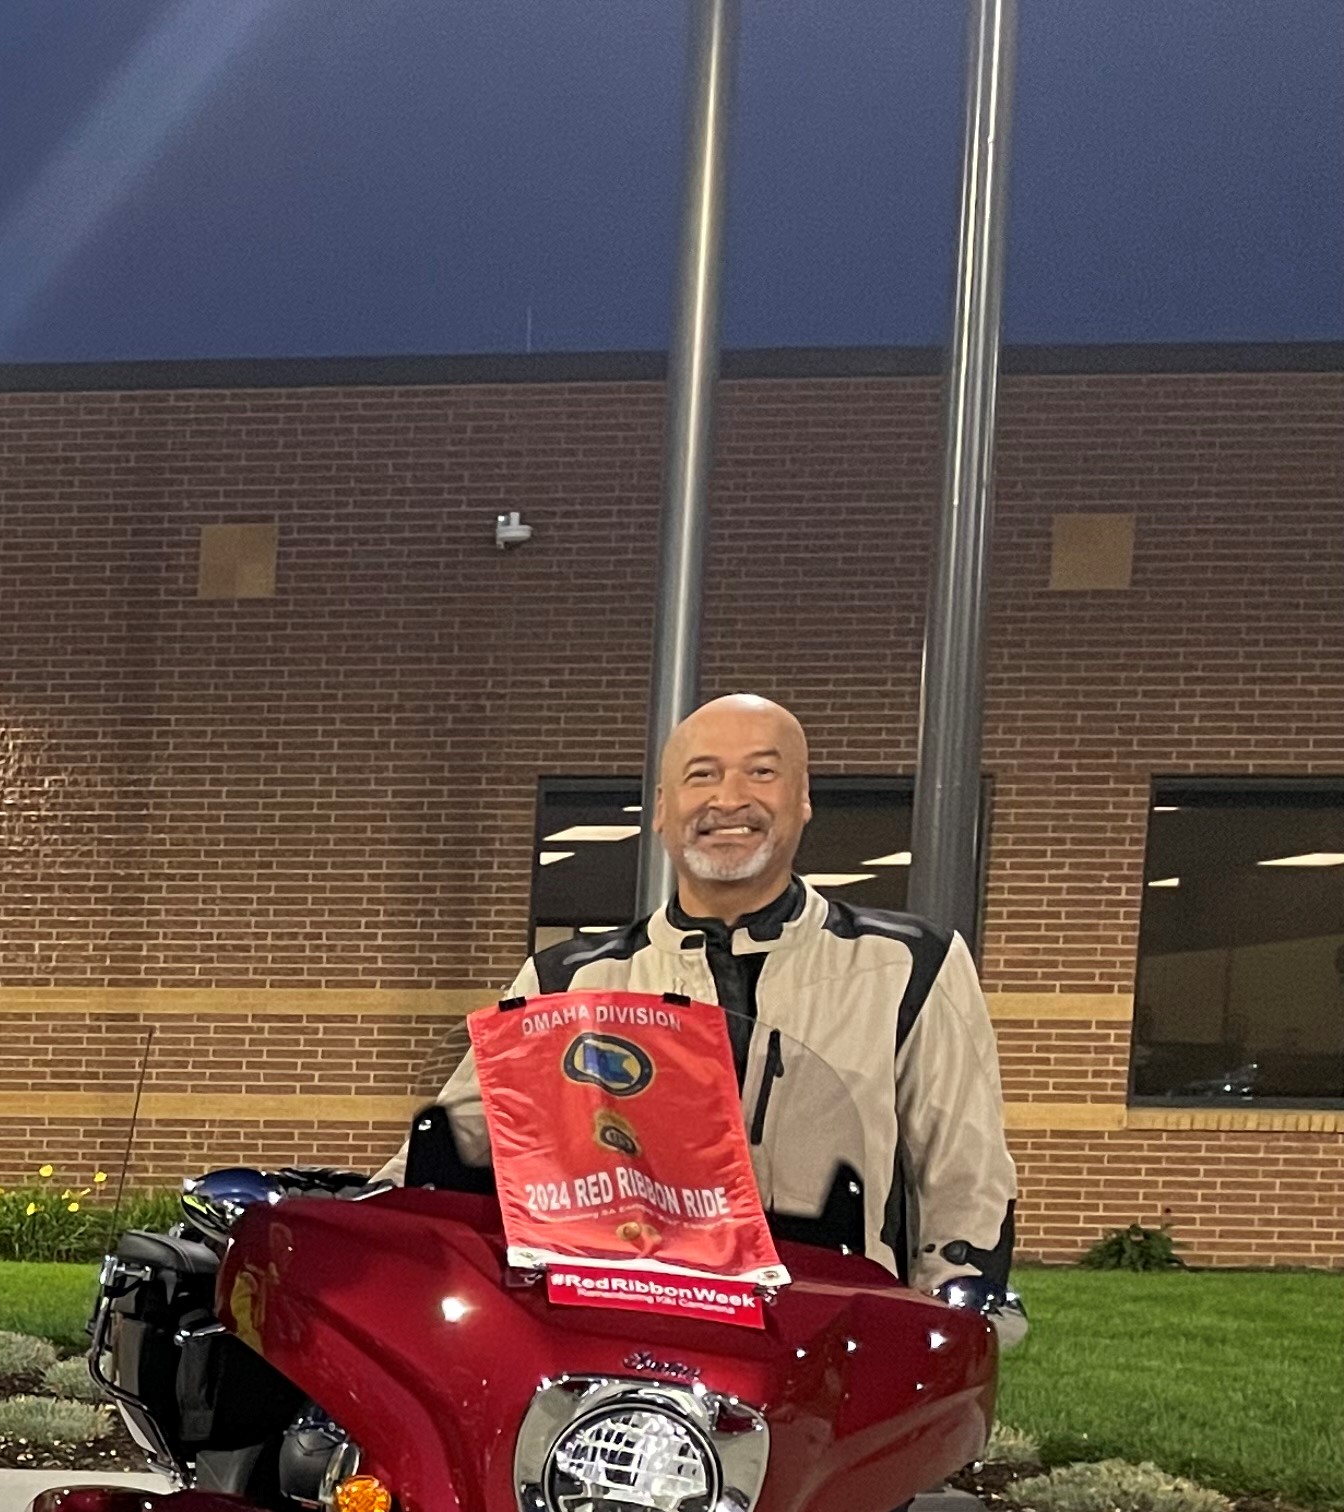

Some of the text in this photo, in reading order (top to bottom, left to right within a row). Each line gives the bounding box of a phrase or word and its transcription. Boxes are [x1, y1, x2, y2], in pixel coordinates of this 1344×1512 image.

[521, 1004, 681, 1036] OMAHA DIVISION
[525, 1182, 571, 1211] 2024
[574, 1171, 614, 1207] RED
[615, 1166, 681, 1215] RIBBON
[682, 1186, 730, 1217] RIDE
[550, 1273, 756, 1308] #RedRibbonWeek
